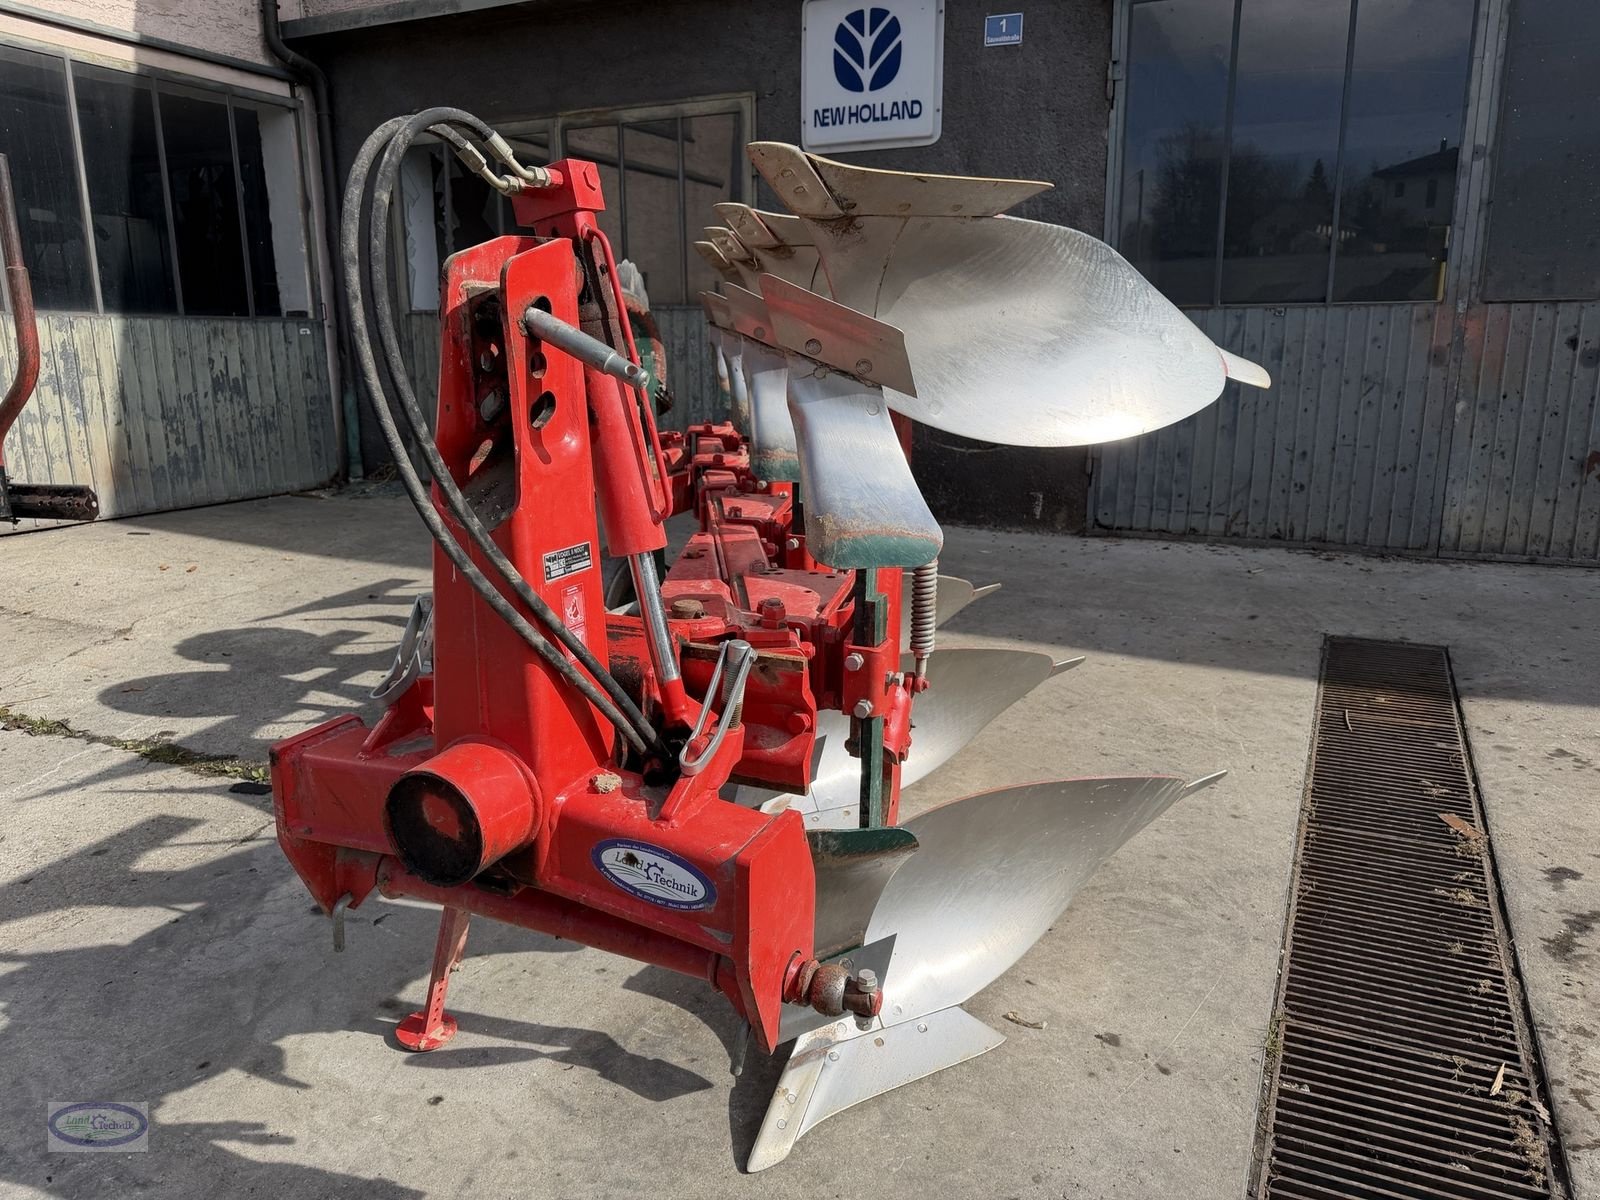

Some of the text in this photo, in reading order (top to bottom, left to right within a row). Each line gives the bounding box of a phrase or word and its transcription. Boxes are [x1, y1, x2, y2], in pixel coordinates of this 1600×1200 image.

[1000, 18, 1006, 33] 1
[813, 99, 923, 128] NEW HOLLAND
[653, 871, 698, 898] Technik
